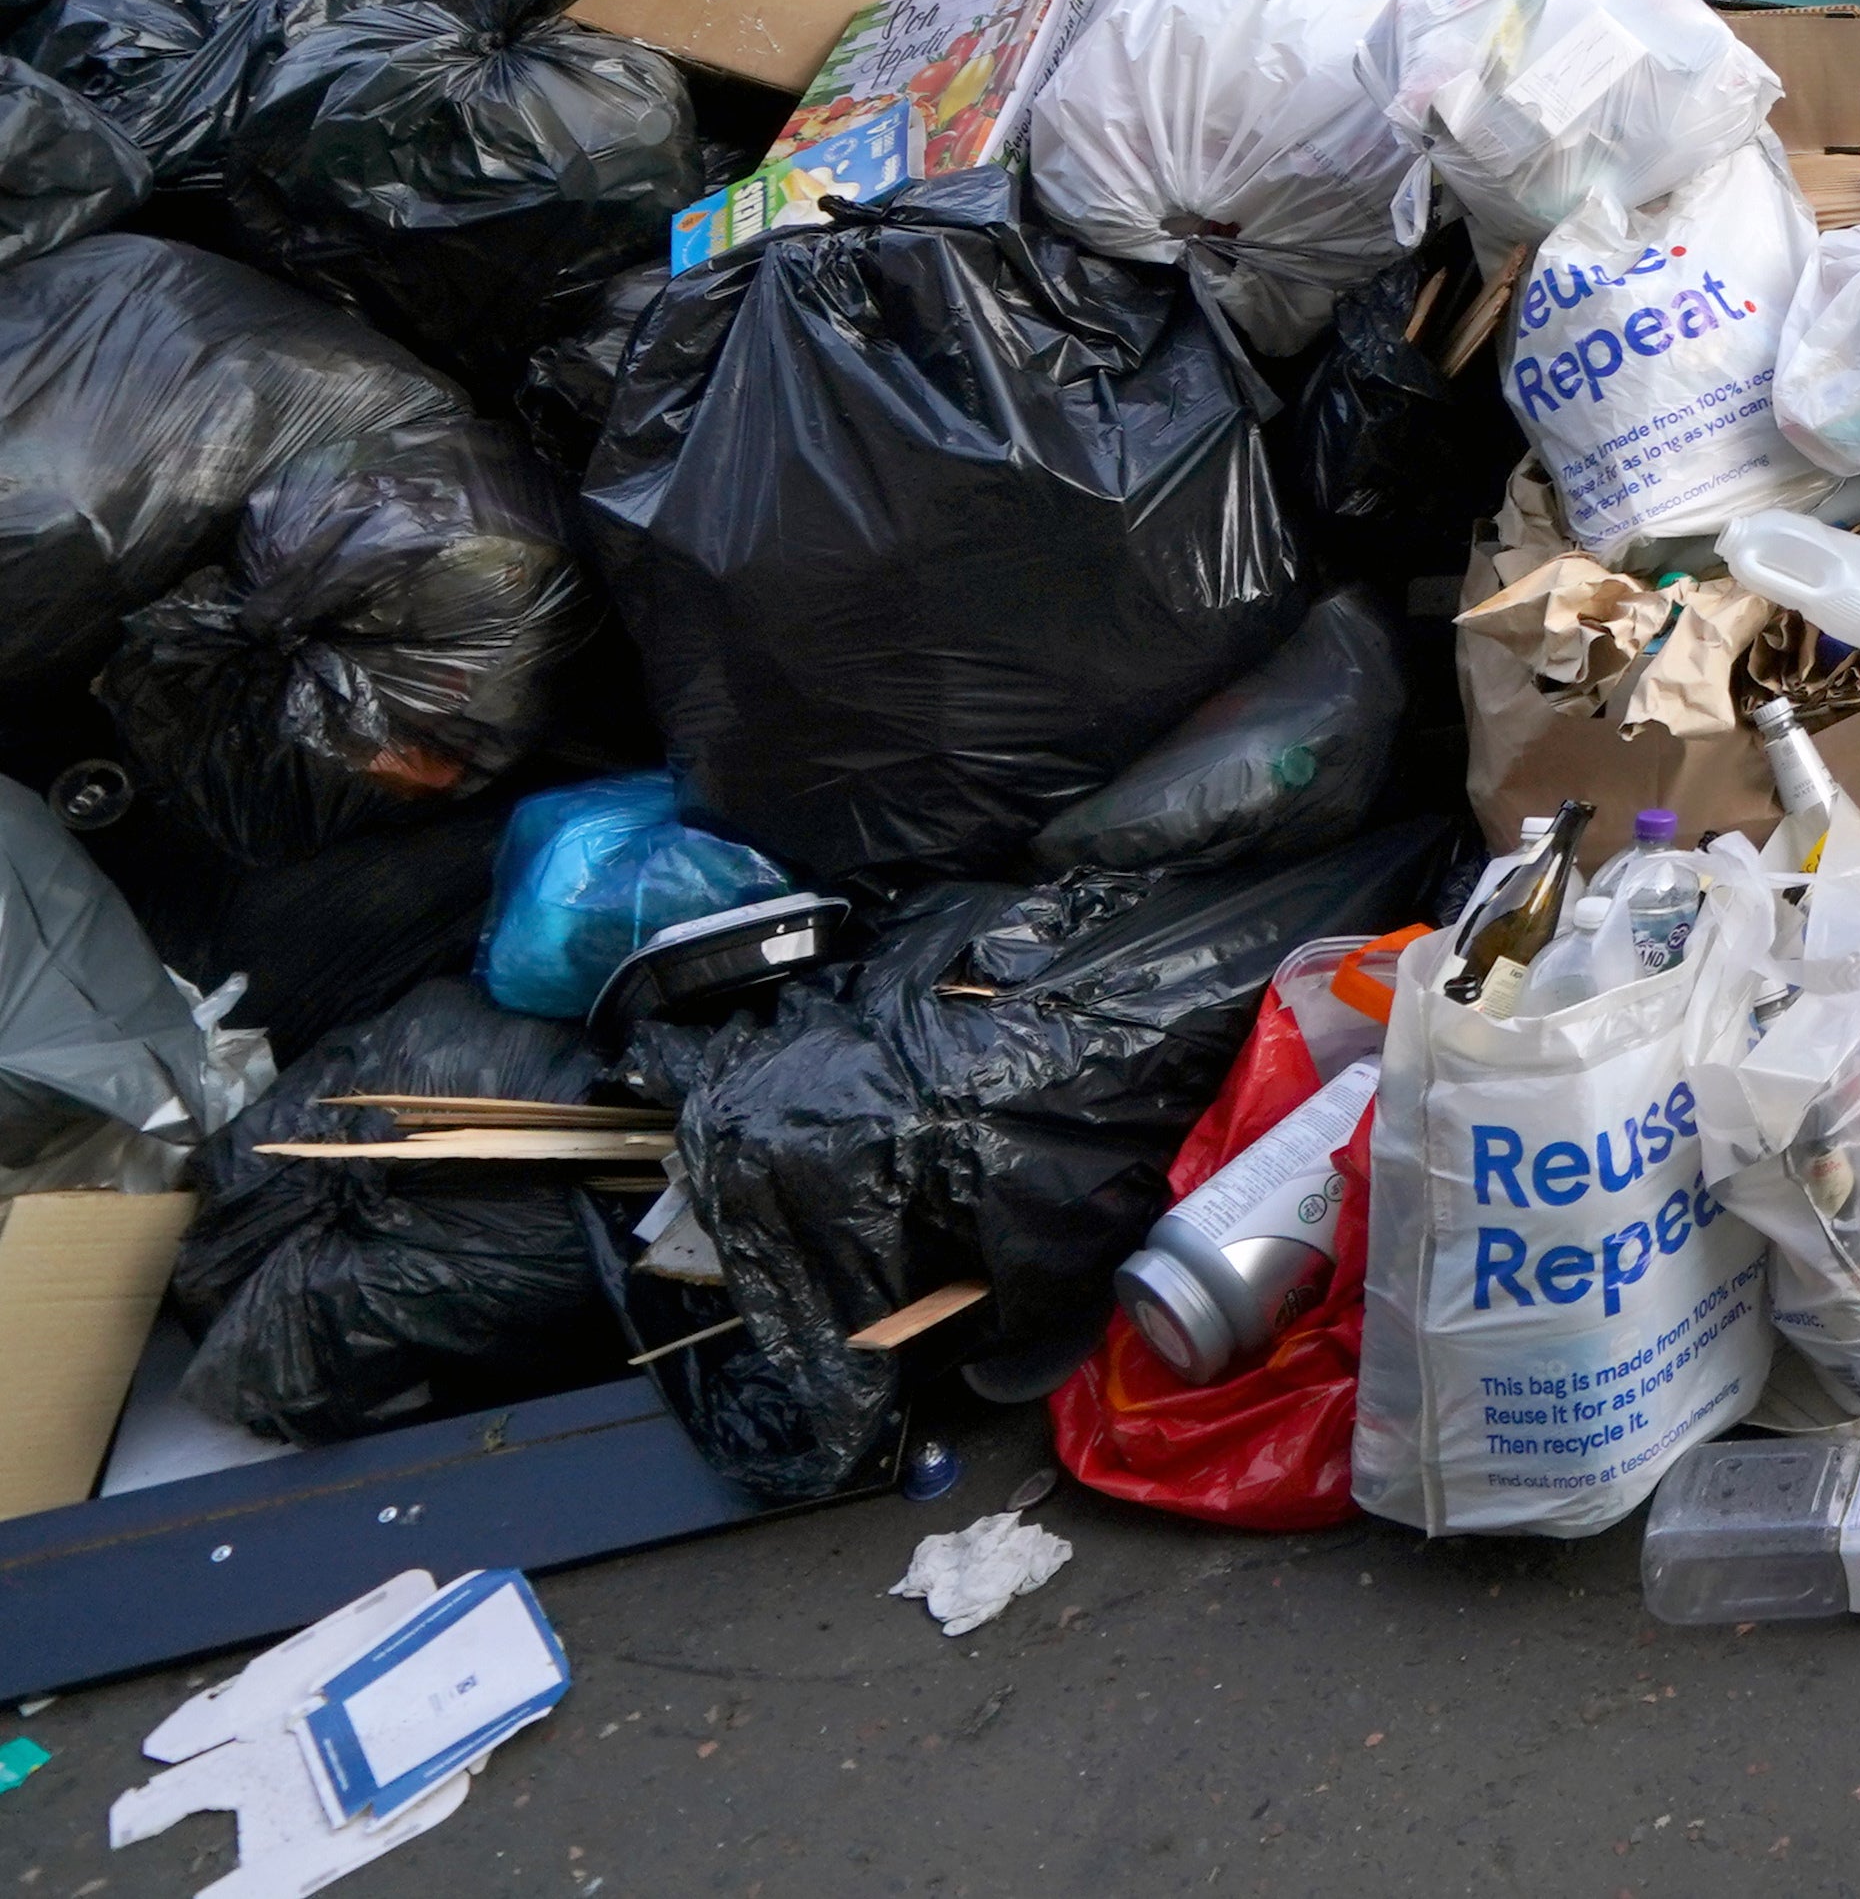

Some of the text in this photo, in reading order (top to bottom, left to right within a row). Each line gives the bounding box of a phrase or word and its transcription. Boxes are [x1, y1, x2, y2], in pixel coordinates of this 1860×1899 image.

[1513, 270, 1757, 423] Repeat.
[1653, 406, 1695, 431] from
[1697, 383, 1743, 411] 100%
[1622, 453, 1642, 472] as
[1643, 436, 1683, 461] long
[1684, 429, 1704, 445] as
[1705, 411, 1736, 437] you
[1631, 512, 1646, 526] at
[1647, 453, 1771, 518] tesco.com/recycling
[1642, 471, 1662, 488] it.
[1471, 1081, 1699, 1209] Reuse
[1480, 1285, 1731, 1399] This bag is made from 100%
[1485, 1300, 1753, 1426] Reuse it for as long as you can.
[1486, 1412, 1649, 1457] Then recycle it.
[1488, 1474, 1520, 1487] Find
[1523, 1475, 1551, 1488] out
[1553, 1471, 1597, 1489] more
[1599, 1464, 1617, 1482] at
